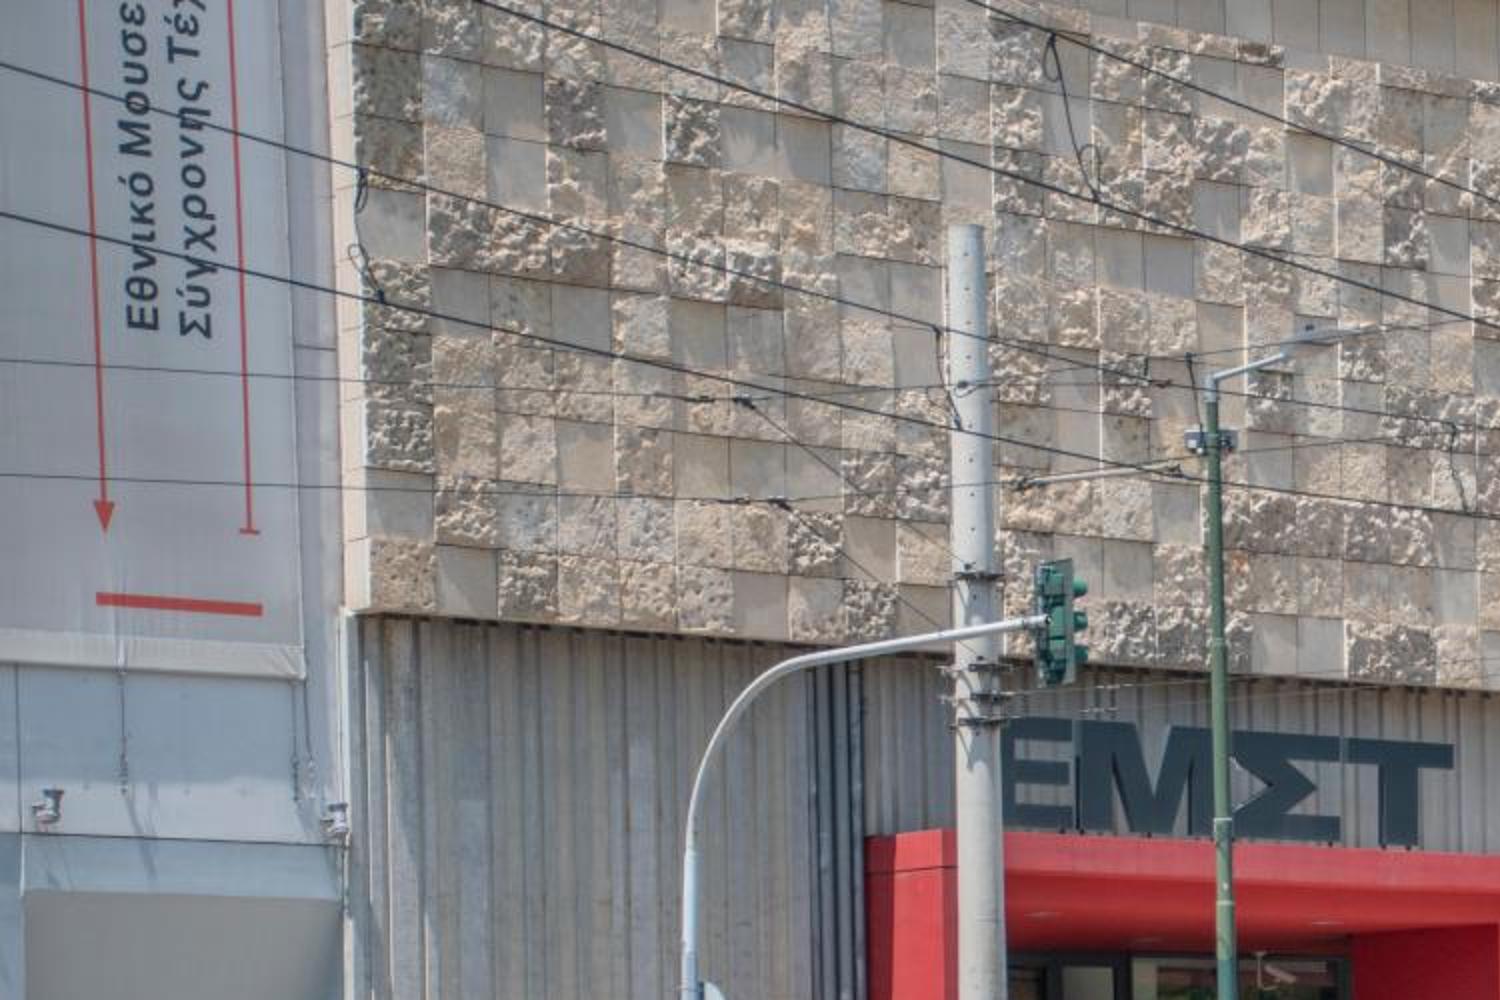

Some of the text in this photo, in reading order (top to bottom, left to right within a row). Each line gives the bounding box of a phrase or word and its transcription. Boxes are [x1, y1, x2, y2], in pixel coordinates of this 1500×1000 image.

[118, 171, 160, 331] Εθνικό
[175, 79, 218, 339] Σύγχρονης
[1002, 716, 1454, 847] ΕΜΣΤ
